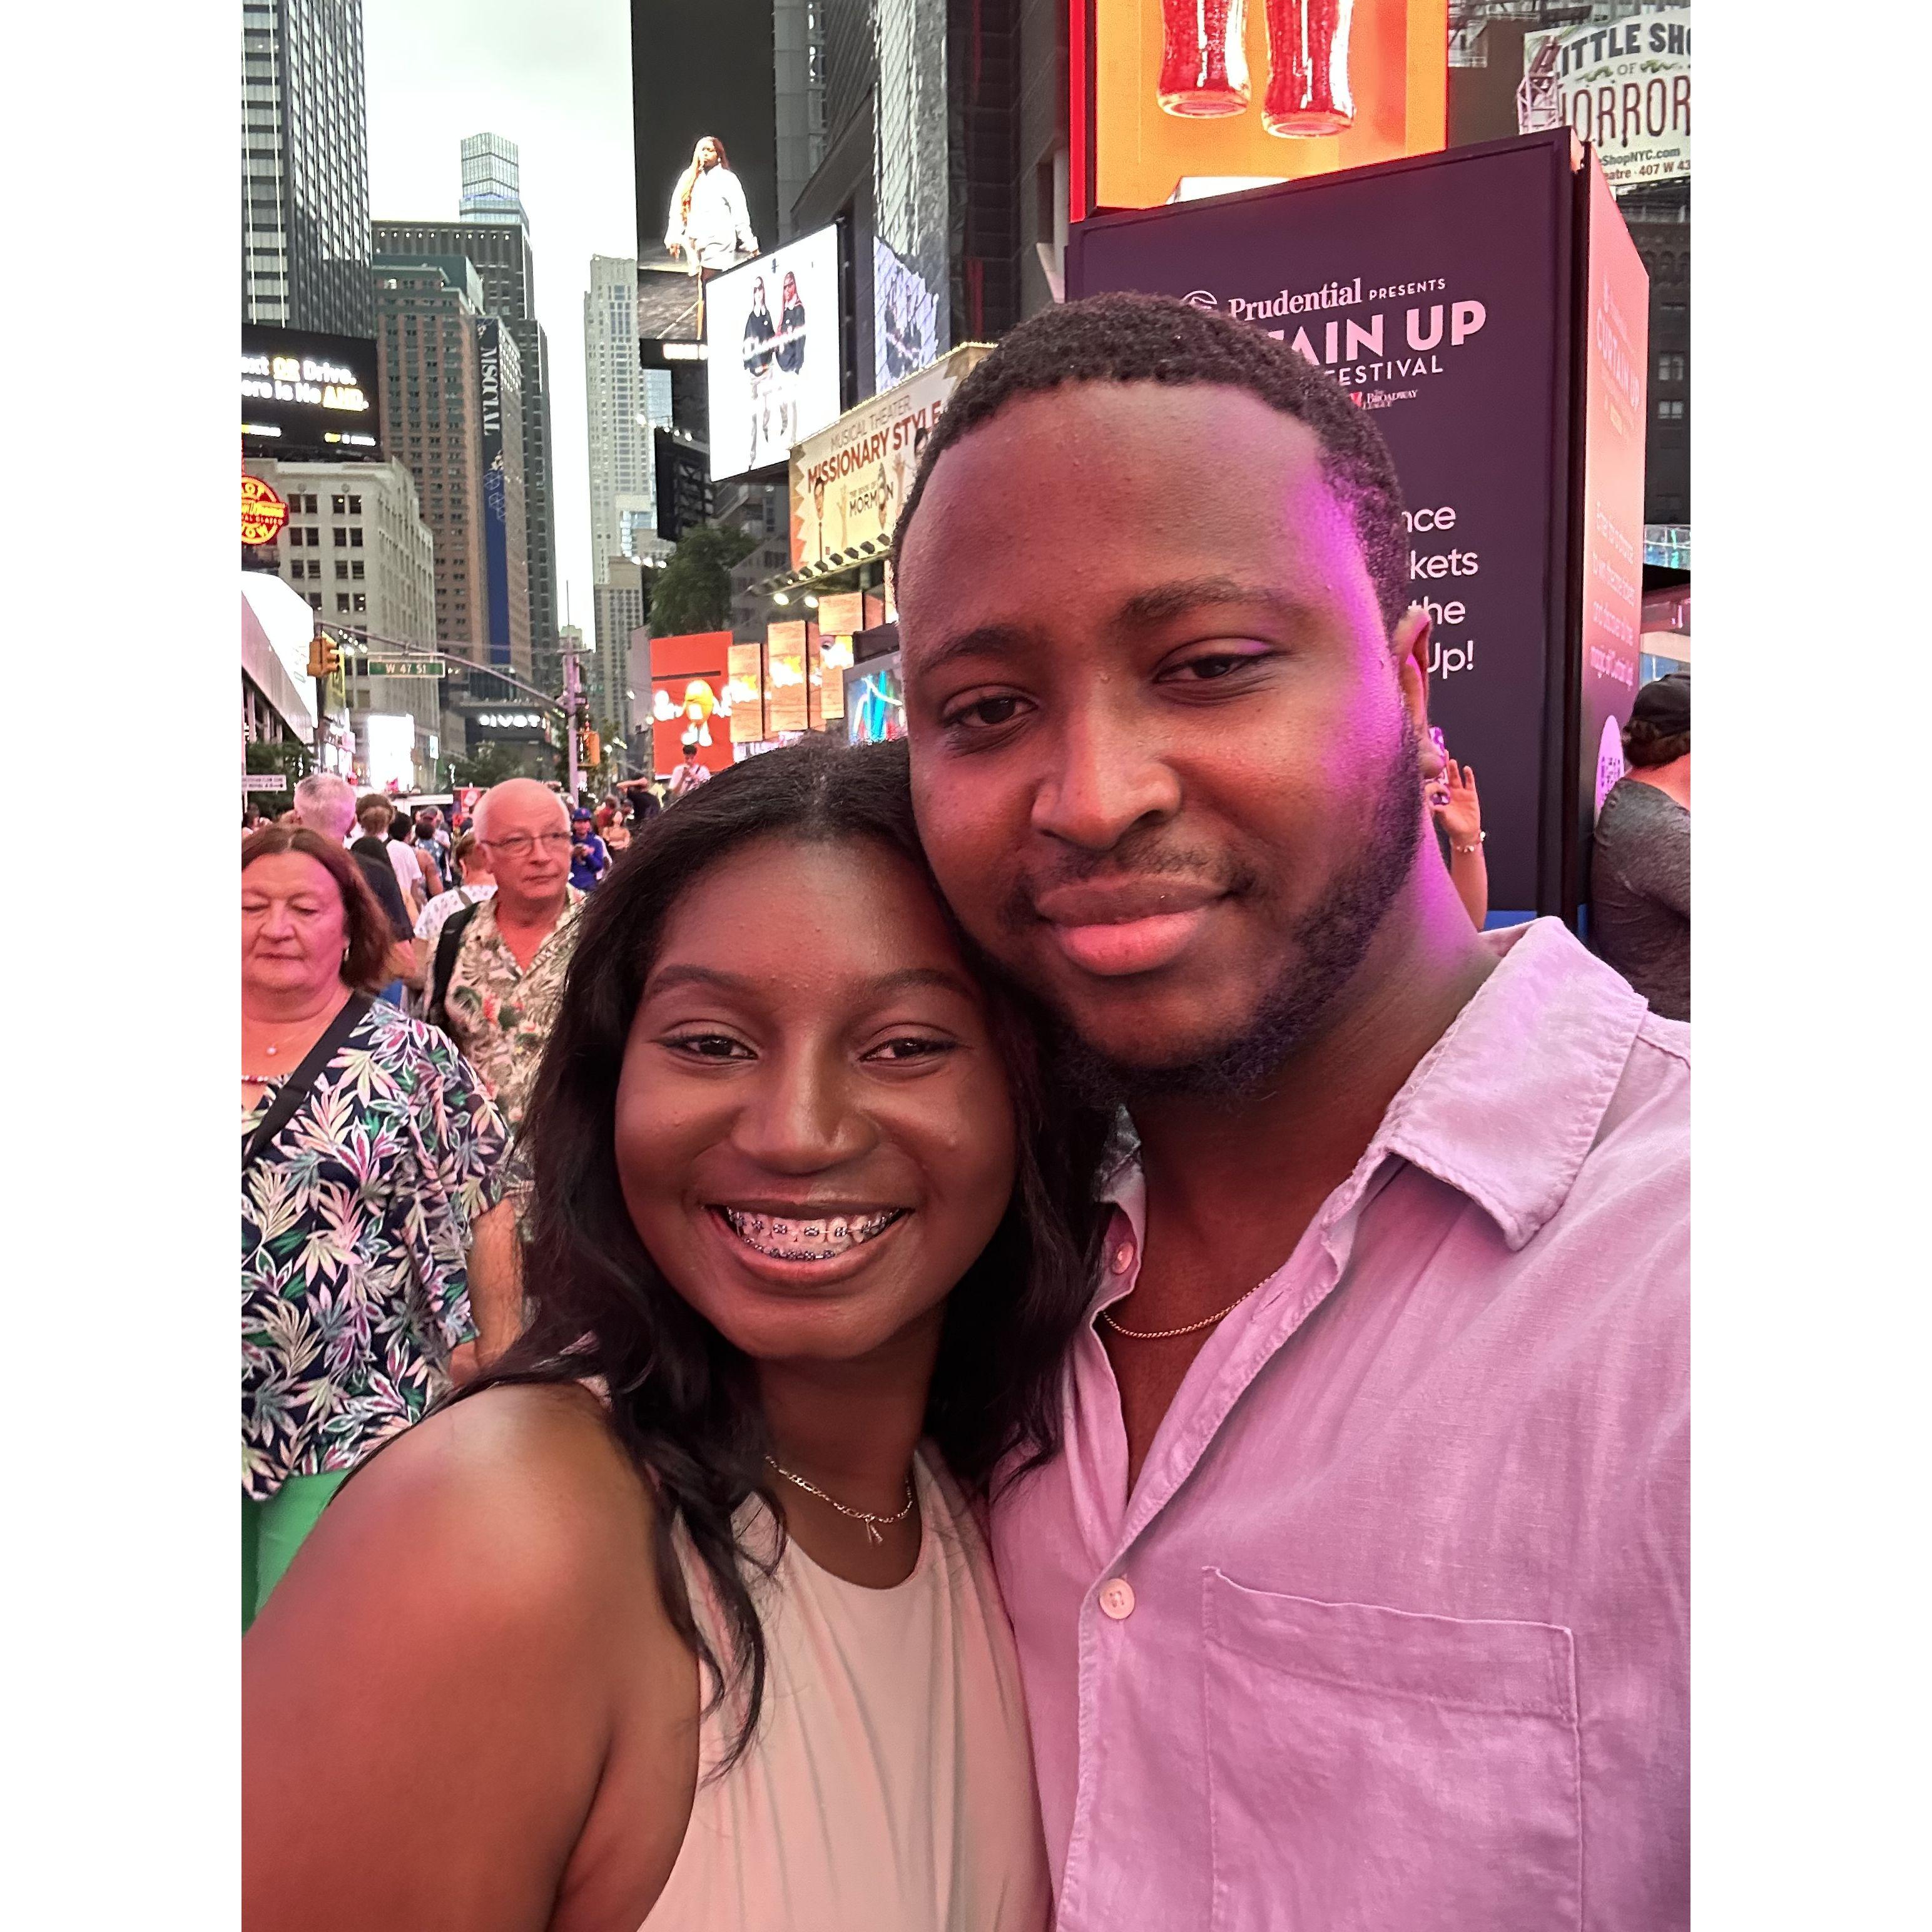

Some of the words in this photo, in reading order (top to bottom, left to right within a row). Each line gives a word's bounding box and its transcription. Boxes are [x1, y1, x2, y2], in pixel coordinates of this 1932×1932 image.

[1562, 24, 1640, 77] ITTLE
[1649, 23, 1690, 55] SH
[1617, 63, 1637, 75] OF
[1639, 163, 1660, 176] 407
[1228, 277, 1362, 322] Prudential
[1369, 278, 1445, 300] PRESENTS
[1268, 314, 1383, 366] AIN
[1406, 300, 1487, 352] UP
[1324, 355, 1443, 386] ESTIVAL
[808, 427, 890, 494] MISSIONARY
[893, 400, 942, 451] STYLE
[1410, 548, 1479, 581] kets
[385, 663, 395, 674] W
